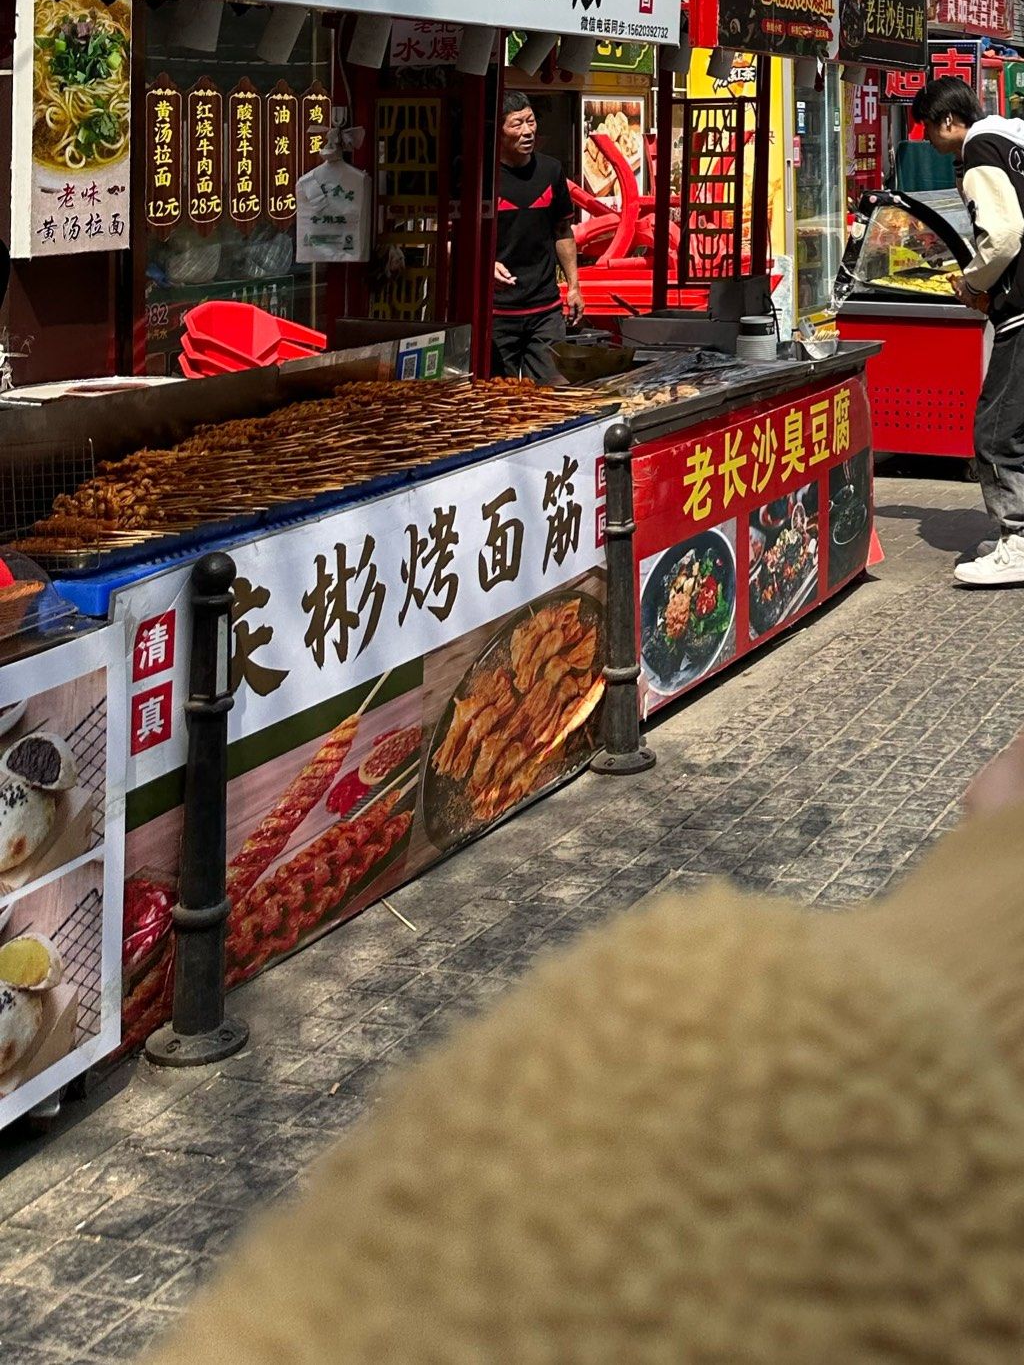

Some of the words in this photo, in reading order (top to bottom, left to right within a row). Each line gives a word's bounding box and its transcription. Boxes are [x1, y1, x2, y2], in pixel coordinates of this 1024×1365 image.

[153, 100, 174, 187] 黄汤拉面
[195, 101, 215, 194] 红烧牛肉面
[236, 104, 253, 193] 酸菜牛肉面
[274, 105, 291, 186] 油泼面
[57, 181, 101, 210] 老味
[148, 198, 179, 218] 12元
[191, 196, 221, 215] 28元
[232, 196, 259, 214] 16元
[269, 194, 296, 213] 16元
[37, 213, 125, 244] 黄汤拉面
[683, 387, 850, 522] 老长沙臭豆腐
[136, 623, 169, 741] 清真
